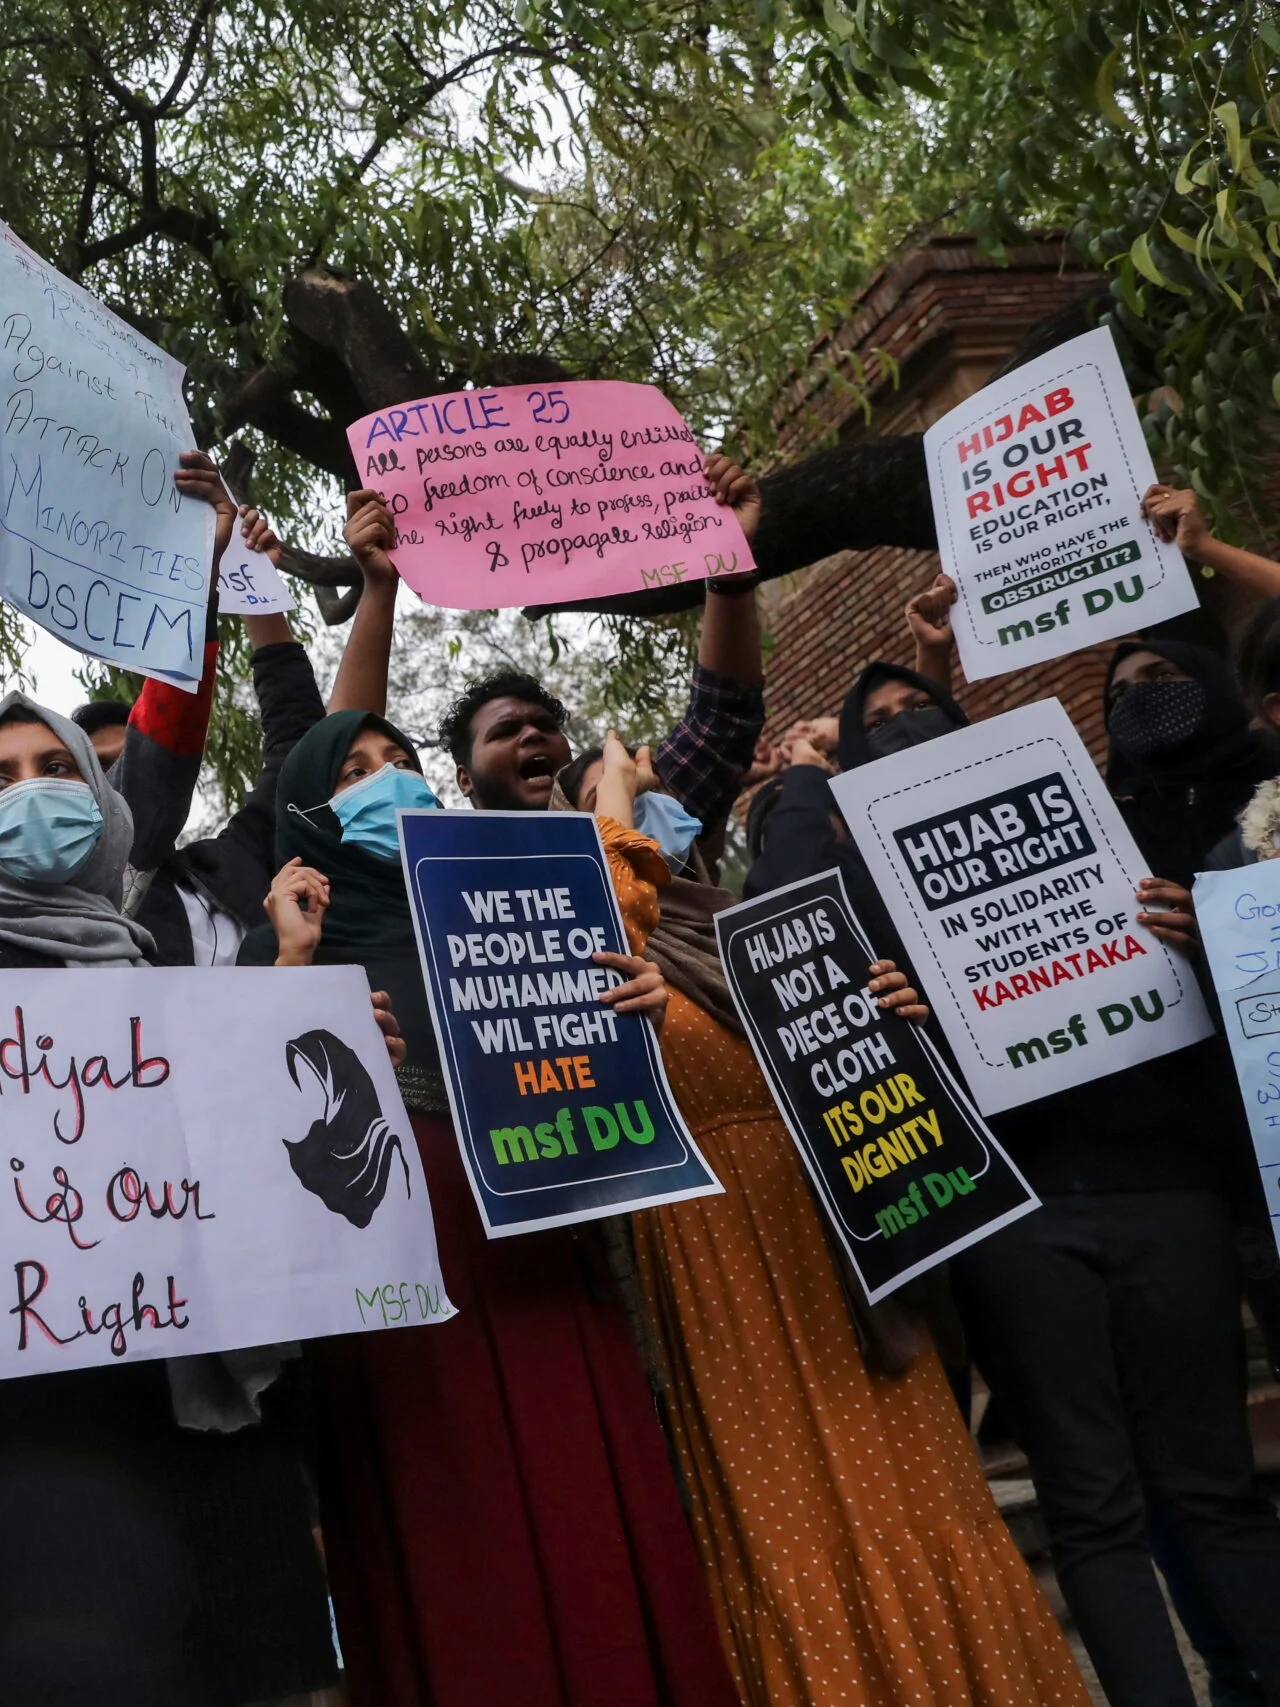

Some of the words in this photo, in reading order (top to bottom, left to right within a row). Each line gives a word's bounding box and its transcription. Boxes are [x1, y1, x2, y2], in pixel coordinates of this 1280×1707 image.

[4, 313, 117, 401] Against
[6, 388, 130, 487] ATTACK
[367, 394, 511, 448] ARTICLE
[527, 391, 569, 423] 25
[367, 449, 405, 477] All
[417, 440, 487, 474] persons
[494, 434, 529, 453] are
[535, 425, 613, 461] equally
[957, 387, 1075, 463] HIJAB
[425, 471, 508, 512] freedom
[518, 469, 544, 495] of
[546, 461, 655, 487] conscience
[660, 455, 704, 476] and
[962, 460, 992, 491] IS
[1003, 418, 1086, 468] OUR
[966, 443, 1092, 519] RIGHT
[5, 453, 205, 591] MINORITIES
[435, 508, 504, 542] right
[571, 497, 590, 515] to
[645, 512, 723, 545] religion
[970, 473, 1108, 541] EDUCATION
[976, 537, 993, 554] IS
[999, 521, 1039, 545] OUR
[1045, 492, 1111, 524] RIGHT,
[641, 561, 689, 589] MSF
[704, 552, 738, 576] DU
[973, 562, 1011, 583] THEN
[1016, 545, 1052, 567] WHO
[1055, 529, 1096, 553] HAVE
[1101, 516, 1130, 536] THE
[989, 561, 1094, 611] OBSTRUCT
[1100, 547, 1132, 570] IT?
[1002, 547, 1084, 586] AUTHORITY
[1088, 539, 1108, 555] TO
[997, 599, 1070, 646] msf
[1082, 574, 1144, 617] DU
[902, 802, 1026, 872] HIJAB
[1028, 785, 1073, 828] IS
[923, 862, 992, 899] OUR
[999, 821, 1085, 877] RIGHT
[461, 891, 514, 923] WE
[515, 887, 575, 920] THE
[940, 913, 967, 939] IN
[975, 863, 1105, 928] SOLIDARITY
[975, 919, 1042, 952] WITH
[1044, 899, 1096, 928] THE
[446, 929, 564, 968] PEOPLE
[567, 927, 607, 959] OF
[744, 916, 811, 974] HIJAB
[807, 908, 836, 947] IS
[964, 928, 1089, 983] STUDENTS
[1095, 912, 1129, 934] OF
[972, 934, 1147, 1012] KARNATAKA
[771, 966, 825, 1013] NOT
[826, 955, 850, 990] A
[470, 1019, 534, 1055] WIL
[534, 1010, 619, 1049] FIGHT
[777, 1004, 850, 1063] PIECE
[843, 986, 884, 1028] OF
[1005, 1014, 1089, 1069] msf
[1096, 989, 1165, 1037] DU
[514, 1055, 596, 1095] HATE
[810, 1031, 897, 1098] CLOTH
[489, 1107, 579, 1165] msf
[581, 1100, 656, 1152] DU
[822, 1094, 864, 1148] ITS
[859, 1072, 926, 1126] OUR
[840, 1108, 944, 1194] DIGNITY
[9, 1157, 102, 1250] is
[106, 1162, 215, 1223] Our
[874, 1180, 930, 1240] msf
[923, 1166, 978, 1208] Du
[8, 1260, 190, 1357] Right
[355, 1283, 411, 1328] MSF
